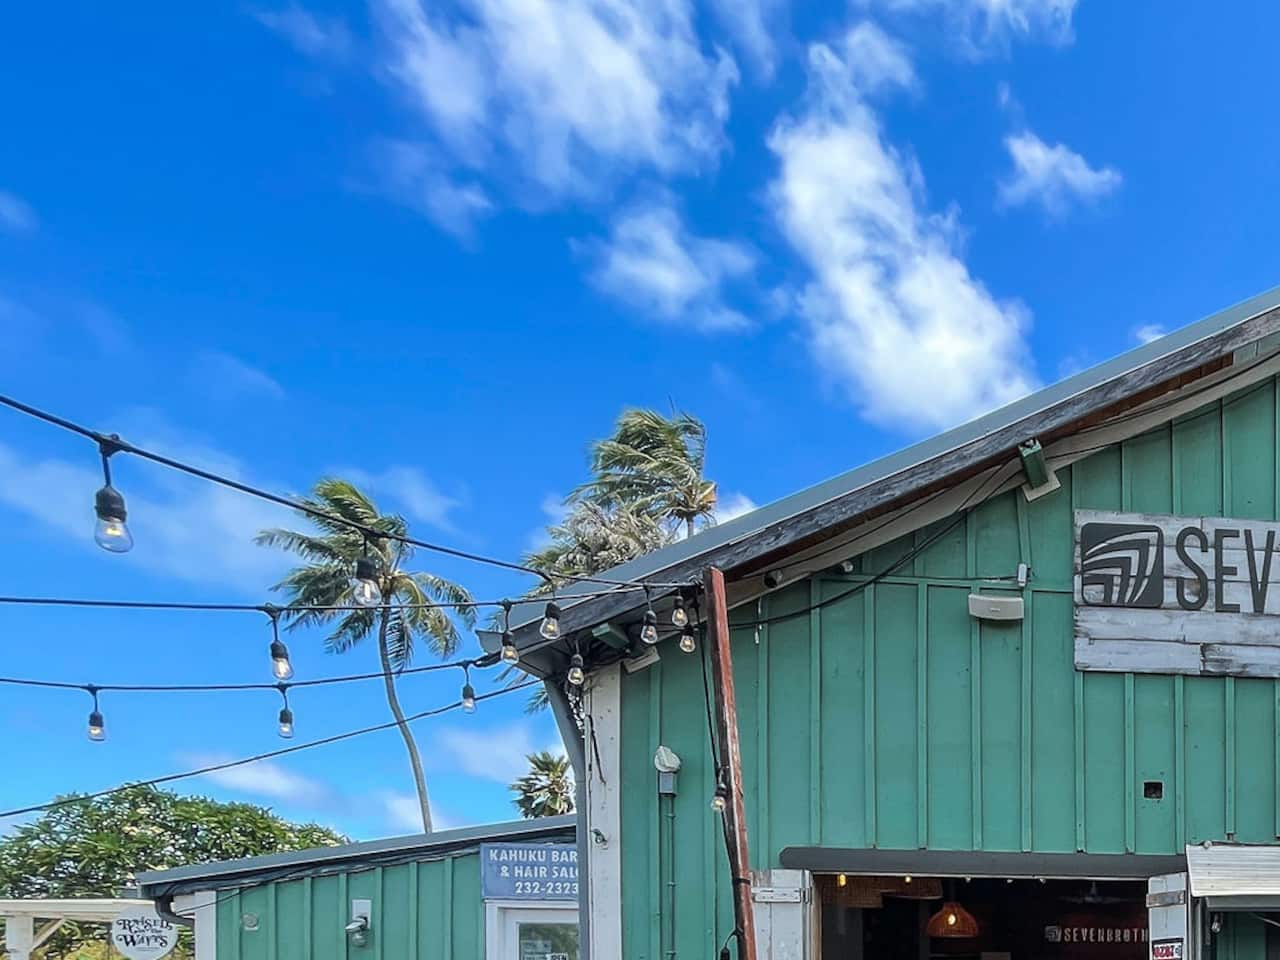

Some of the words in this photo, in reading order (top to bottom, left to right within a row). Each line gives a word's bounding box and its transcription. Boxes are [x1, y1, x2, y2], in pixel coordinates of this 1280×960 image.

[489, 849, 547, 862] KAHUKU
[500, 865, 510, 878] &
[514, 865, 547, 878] HAIR
[551, 866, 579, 879] SAL
[515, 881, 579, 894] 232-2323
